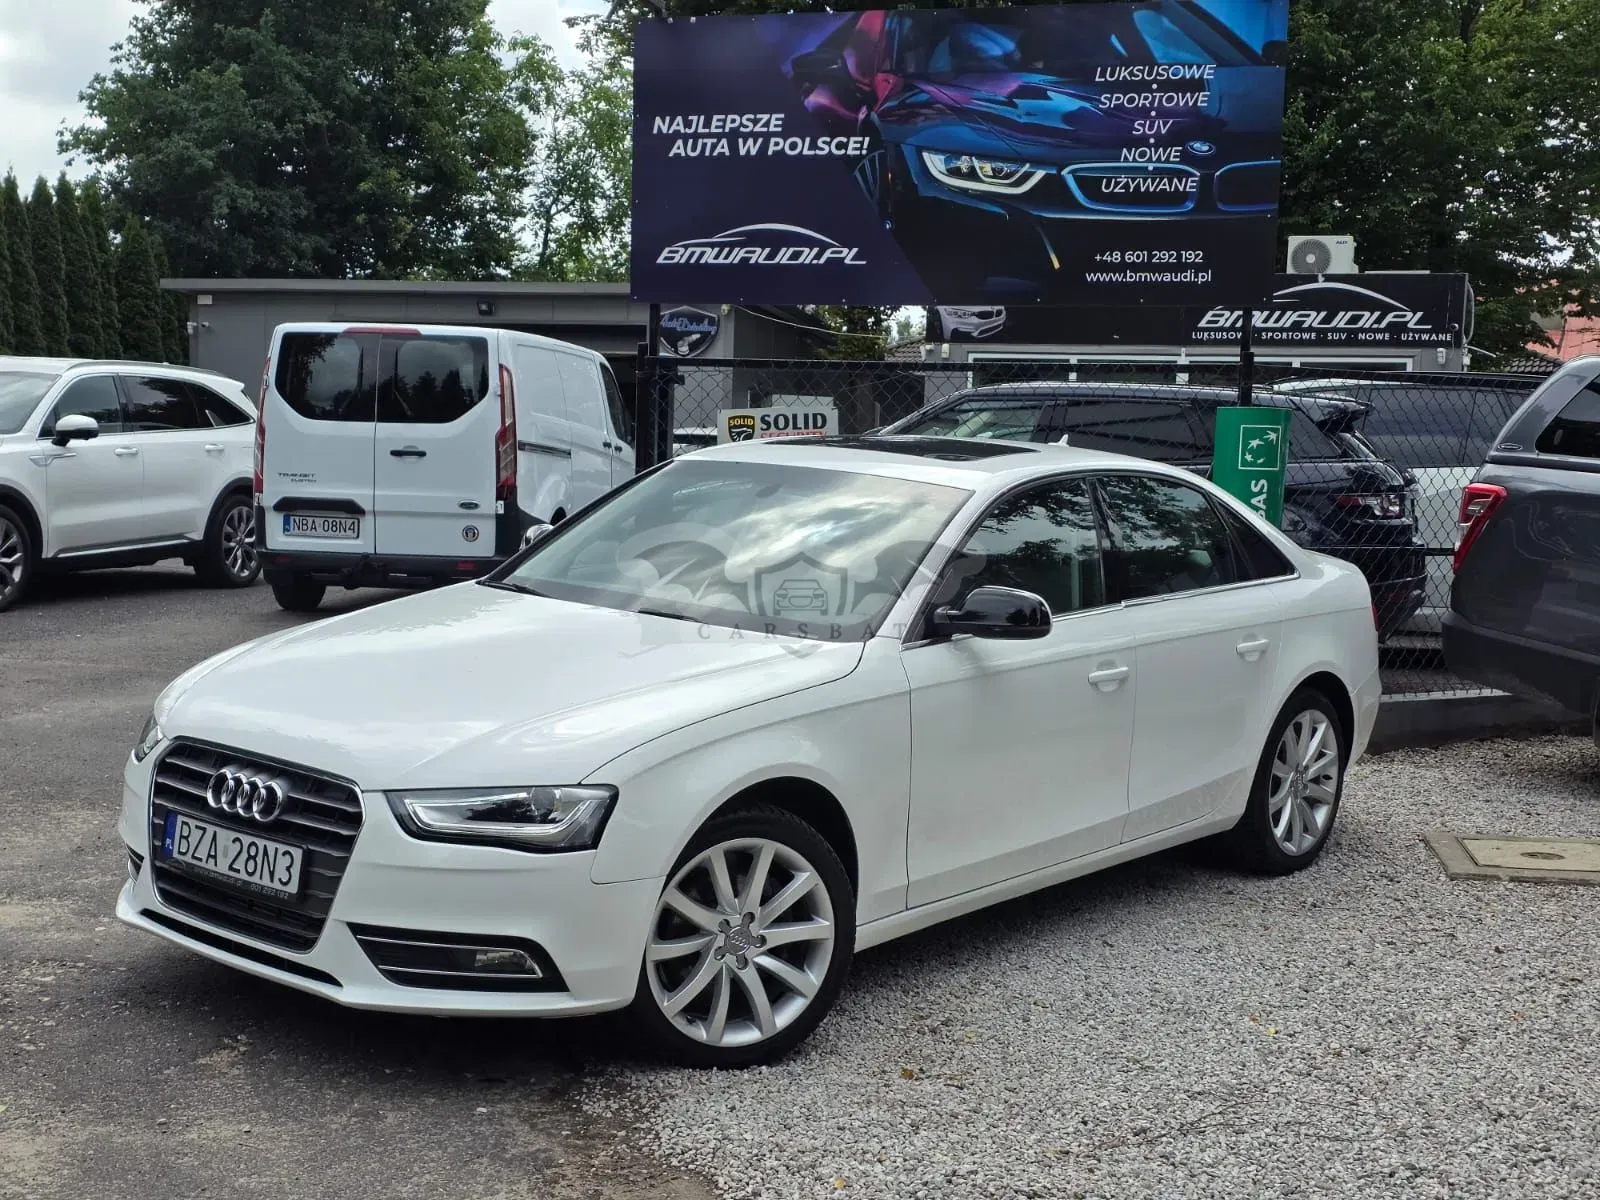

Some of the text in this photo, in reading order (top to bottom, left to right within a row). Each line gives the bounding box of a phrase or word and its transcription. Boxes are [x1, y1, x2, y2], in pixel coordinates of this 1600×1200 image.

[1095, 64, 1217, 82] LUKSUSOWE
[1099, 91, 1211, 109] SPORTOWE
[653, 113, 785, 134] NAJLEPSZE
[1132, 119, 1174, 135] SUV
[668, 136, 871, 157] AUTA W POLSCE!
[1120, 146, 1183, 162] NOWE
[1101, 174, 1199, 193] UŻYWANE
[655, 246, 868, 265] BMWAUDI.PL
[1094, 250, 1204, 264] +48 601 292 192
[1085, 269, 1212, 285] www.bmwaudi.pl
[1260, 331, 1317, 340] SPORTOWE
[1326, 331, 1347, 340] SUV
[1358, 332, 1390, 341] NOWE
[1400, 331, 1453, 341] UŻYWANE
[729, 412, 828, 432] SOLID SOLID
[292, 517, 318, 533] NBA
[322, 519, 356, 534] 08N4
[177, 819, 219, 868] BZA
[228, 836, 295, 887] 28N3
